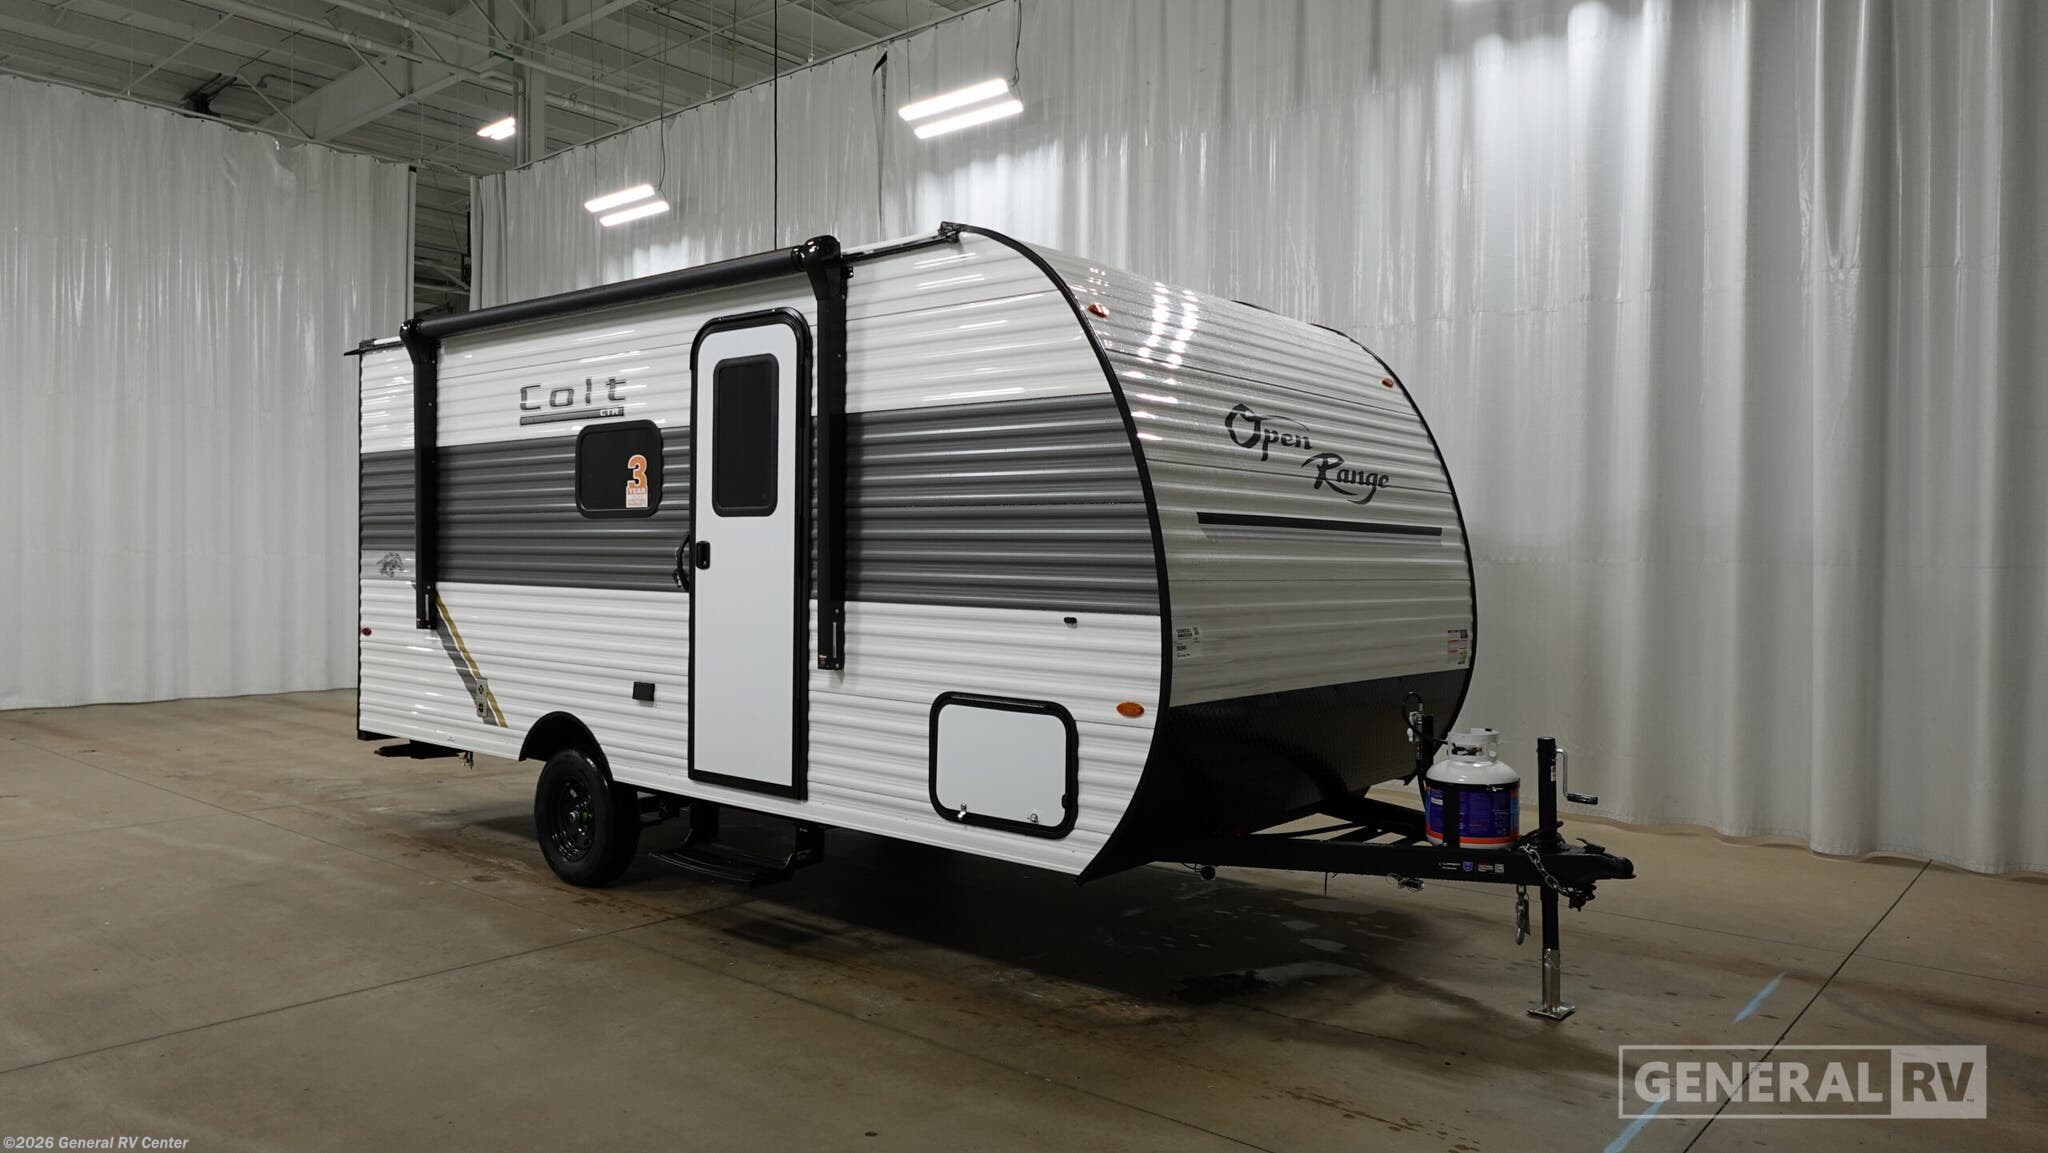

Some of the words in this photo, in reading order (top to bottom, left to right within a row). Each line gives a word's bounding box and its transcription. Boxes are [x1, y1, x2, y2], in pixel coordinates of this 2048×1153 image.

[520, 377, 626, 411] Colt
[600, 409, 620, 417] CTR
[1225, 403, 1313, 462] Open
[628, 455, 647, 488] 3
[1301, 452, 1390, 505] Range
